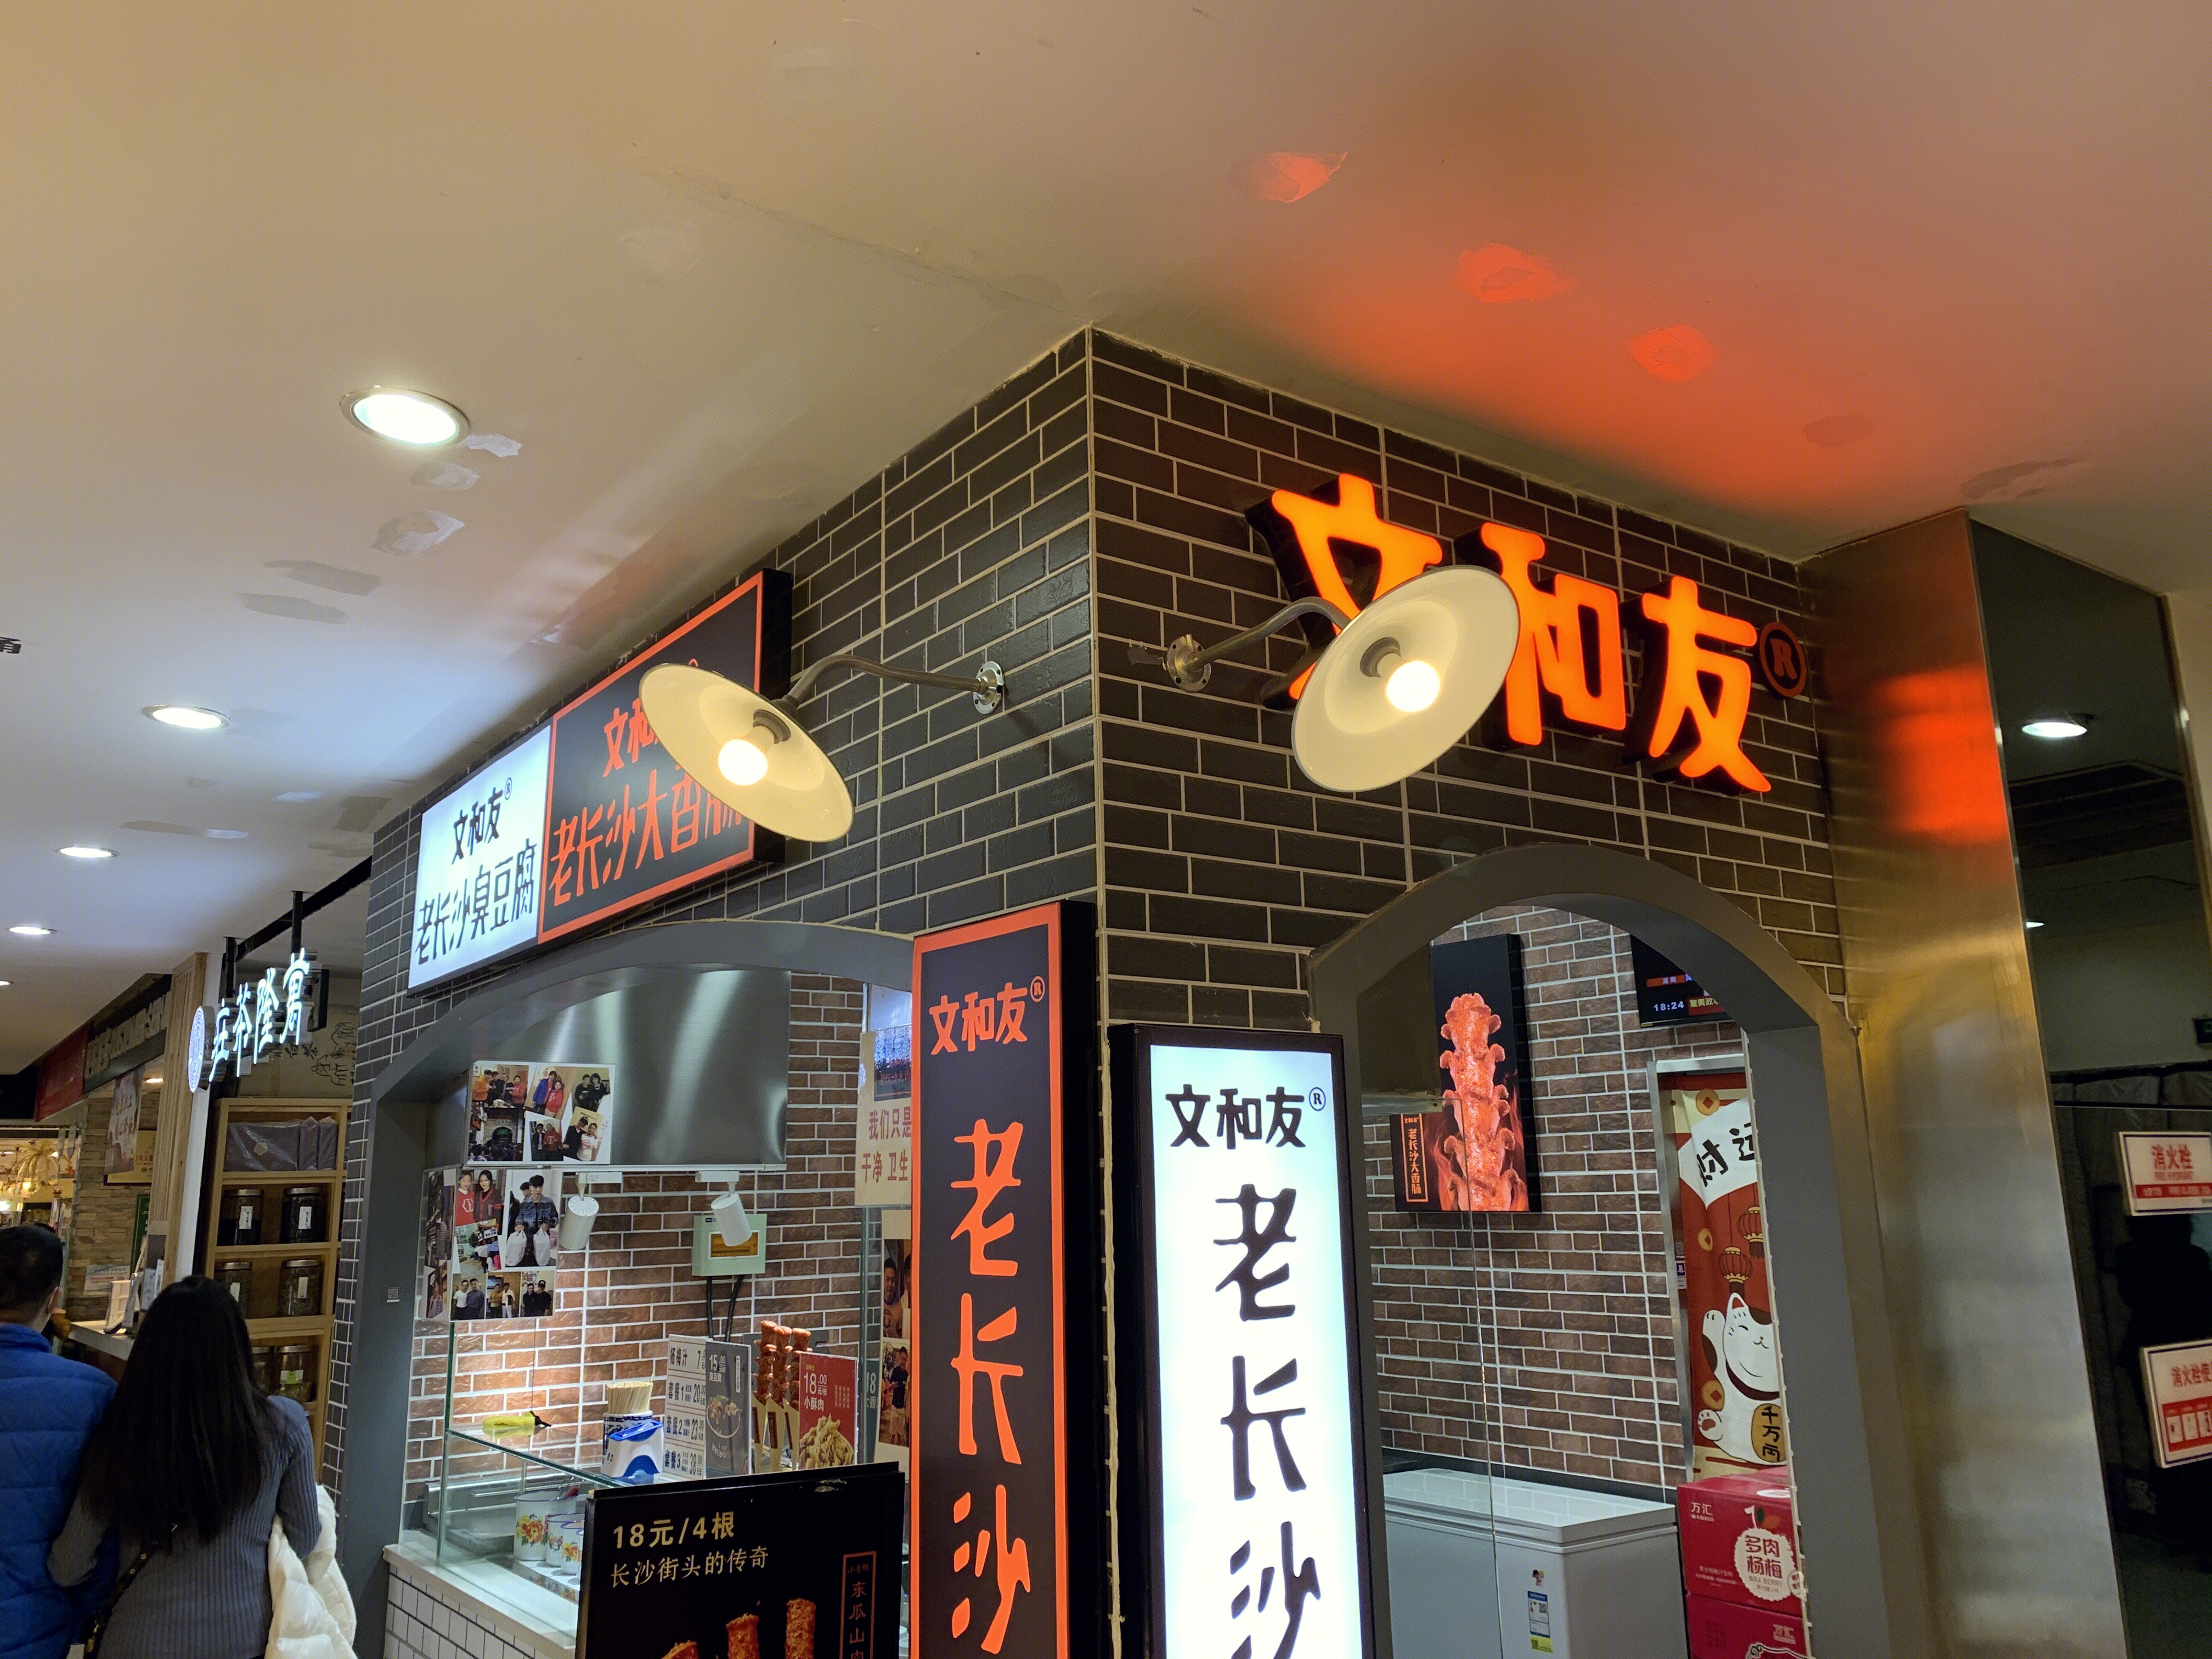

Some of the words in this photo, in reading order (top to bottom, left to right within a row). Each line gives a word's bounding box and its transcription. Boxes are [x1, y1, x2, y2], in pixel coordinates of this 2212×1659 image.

[602, 697, 660, 777] 文和
[452, 787, 504, 865] 文和友
[415, 837, 538, 966] 老长沙臭豆腐
[928, 981, 1028, 1056] 文和友
[1653, 1000, 1684, 1012] 18:24
[868, 1106, 912, 1141] 我们只是
[1165, 1084, 1307, 1150] 文和友
[1407, 1128, 1421, 1194] 老长沙大香肠
[2151, 1144, 2193, 1170] 消火栓
[950, 1118, 1031, 1655] 老长沙
[2171, 1362, 2212, 1388] 消火栓使
[803, 1396, 824, 1412] 小酥肉
[1212, 1184, 1321, 1659] 老长沙
[612, 1510, 735, 1549] 18元/4根
[1690, 1502, 1713, 1516] 万汇
[1745, 1534, 1780, 1558] 多肉
[610, 1545, 769, 1589] 长沙街头的传奇
[1746, 1555, 1783, 1579] 杨梅
